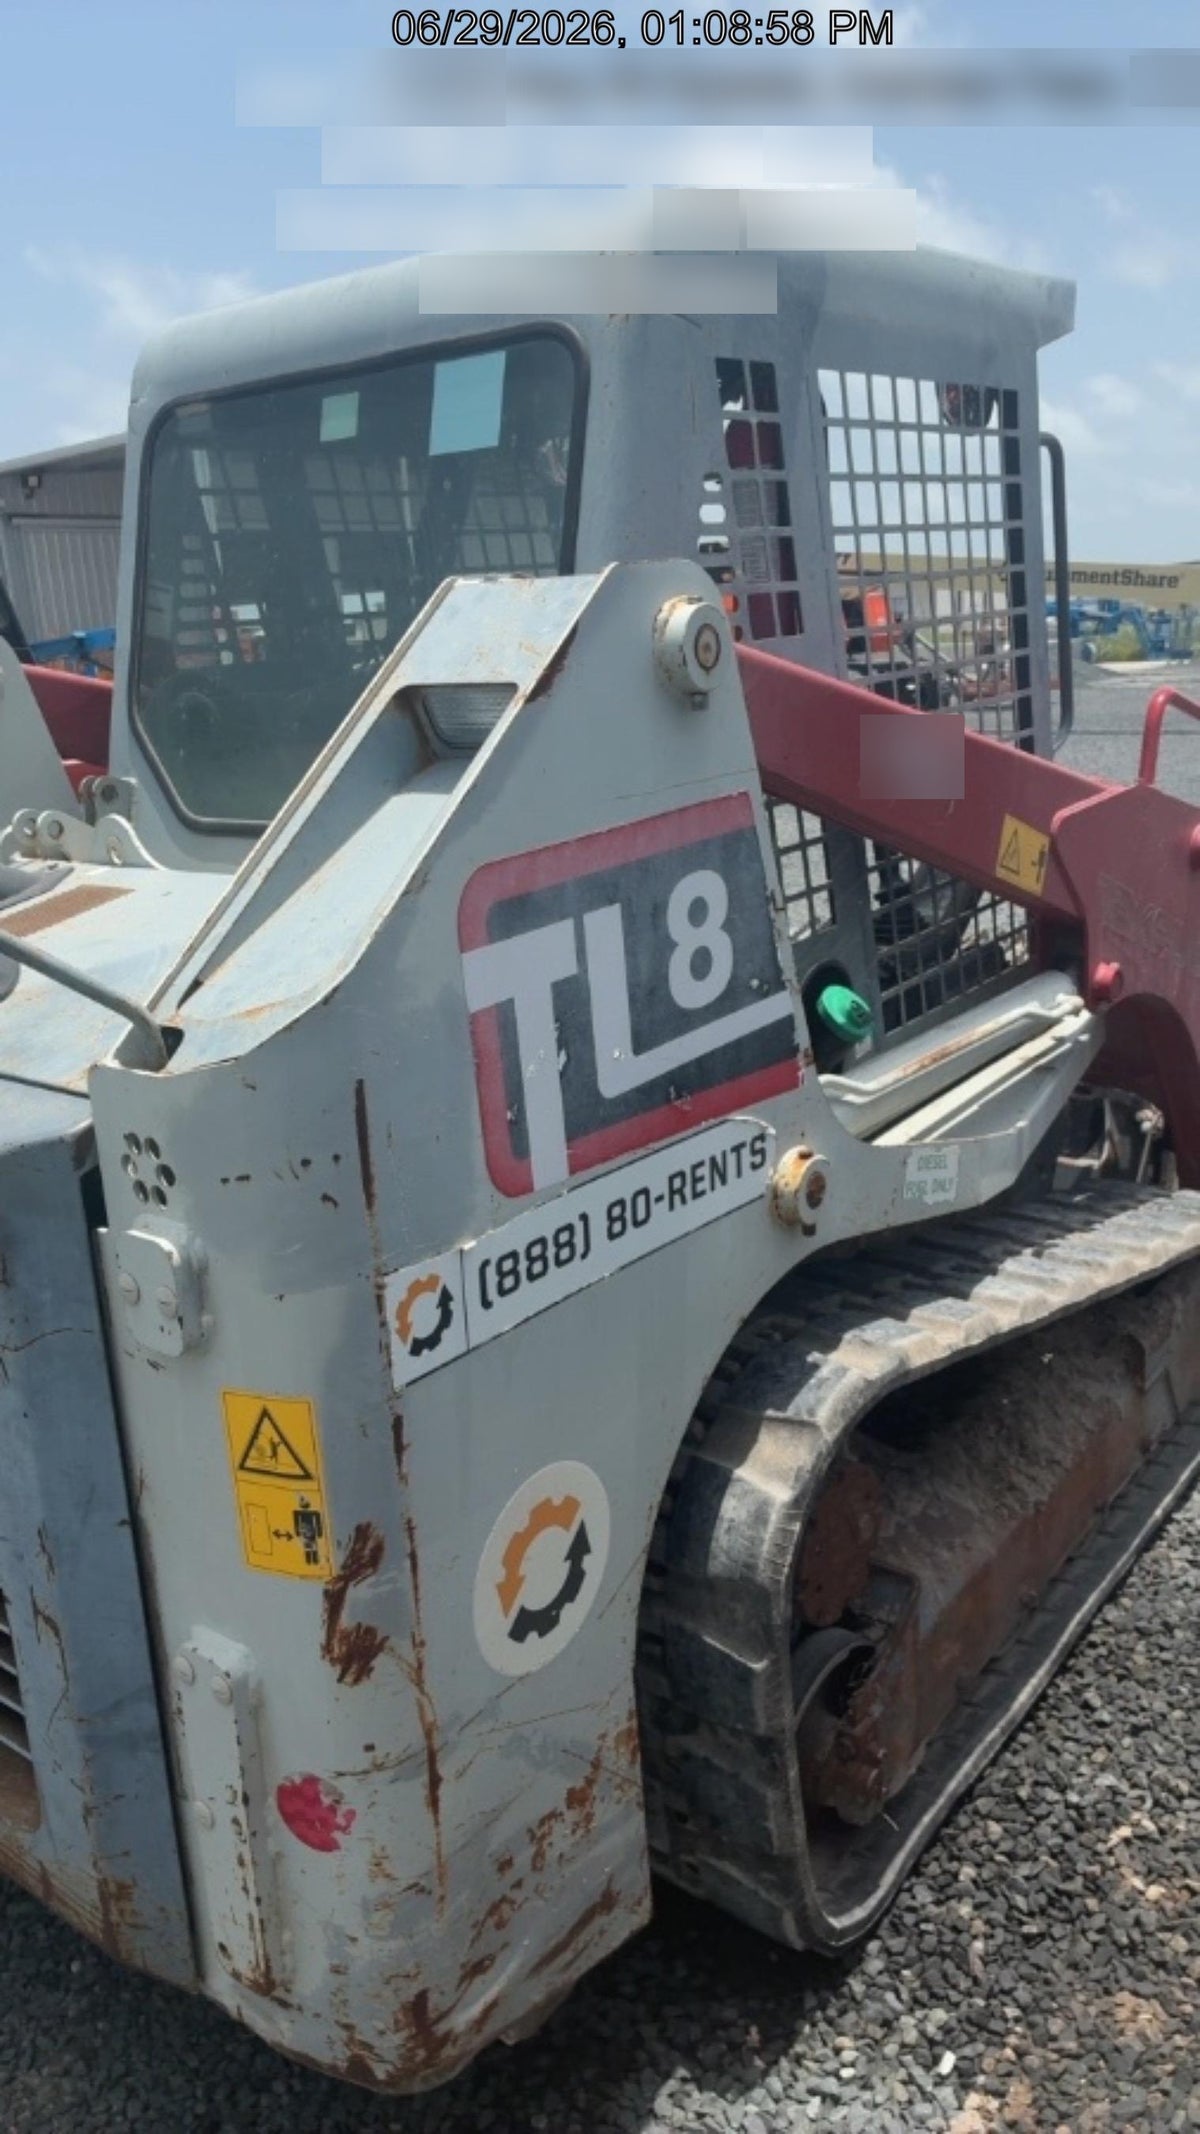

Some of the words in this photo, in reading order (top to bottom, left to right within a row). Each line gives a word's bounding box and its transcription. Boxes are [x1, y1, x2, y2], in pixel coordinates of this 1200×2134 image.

[461, 869, 792, 1192] TL8
[478, 1212, 592, 1311] (888)
[606, 1132, 768, 1242] 80-RENTS
